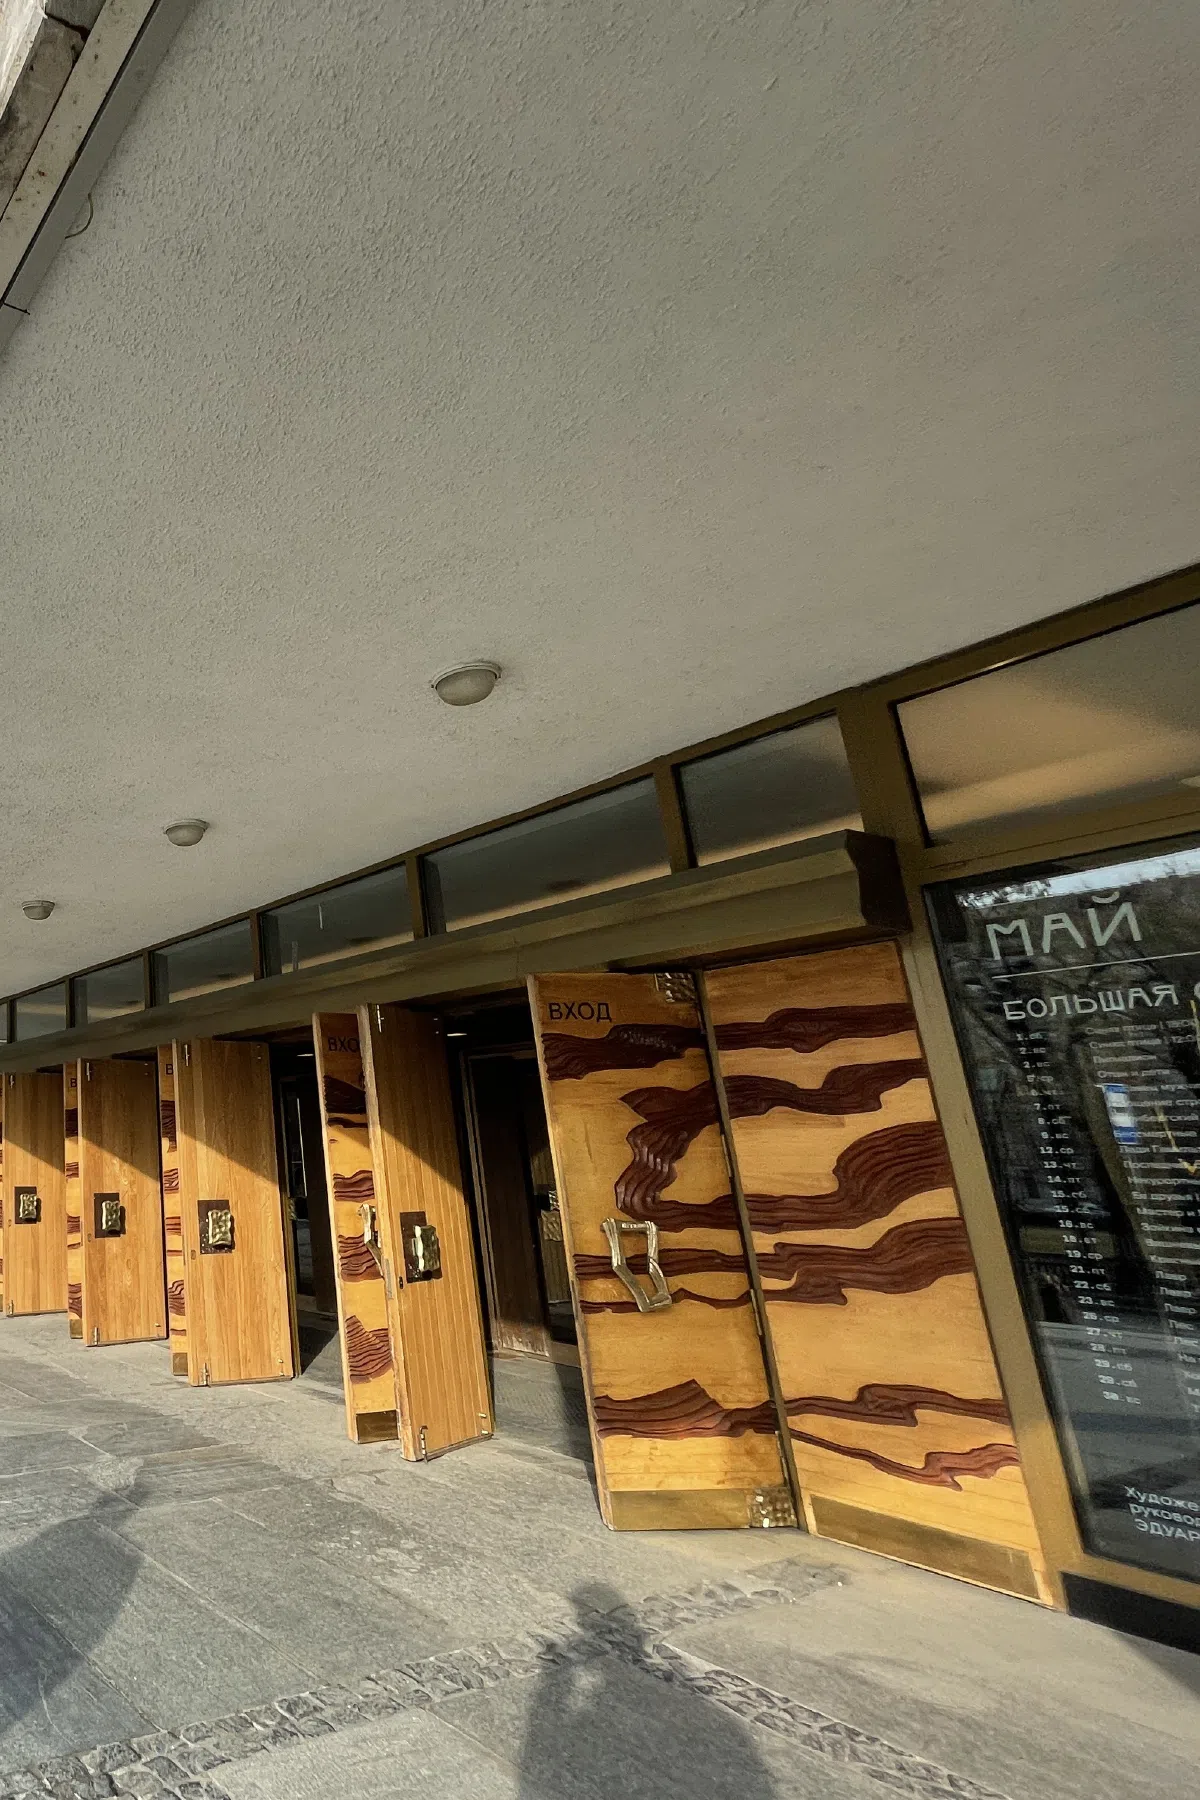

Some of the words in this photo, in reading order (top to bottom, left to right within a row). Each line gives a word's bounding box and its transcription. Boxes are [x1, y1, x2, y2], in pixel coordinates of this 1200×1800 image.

[986, 892, 1142, 960] МАЙ
[548, 1002, 612, 1023] ВХОД
[1002, 984, 1179, 1021] БОЛЬШАЯ
[328, 1036, 358, 1053] ВХО
